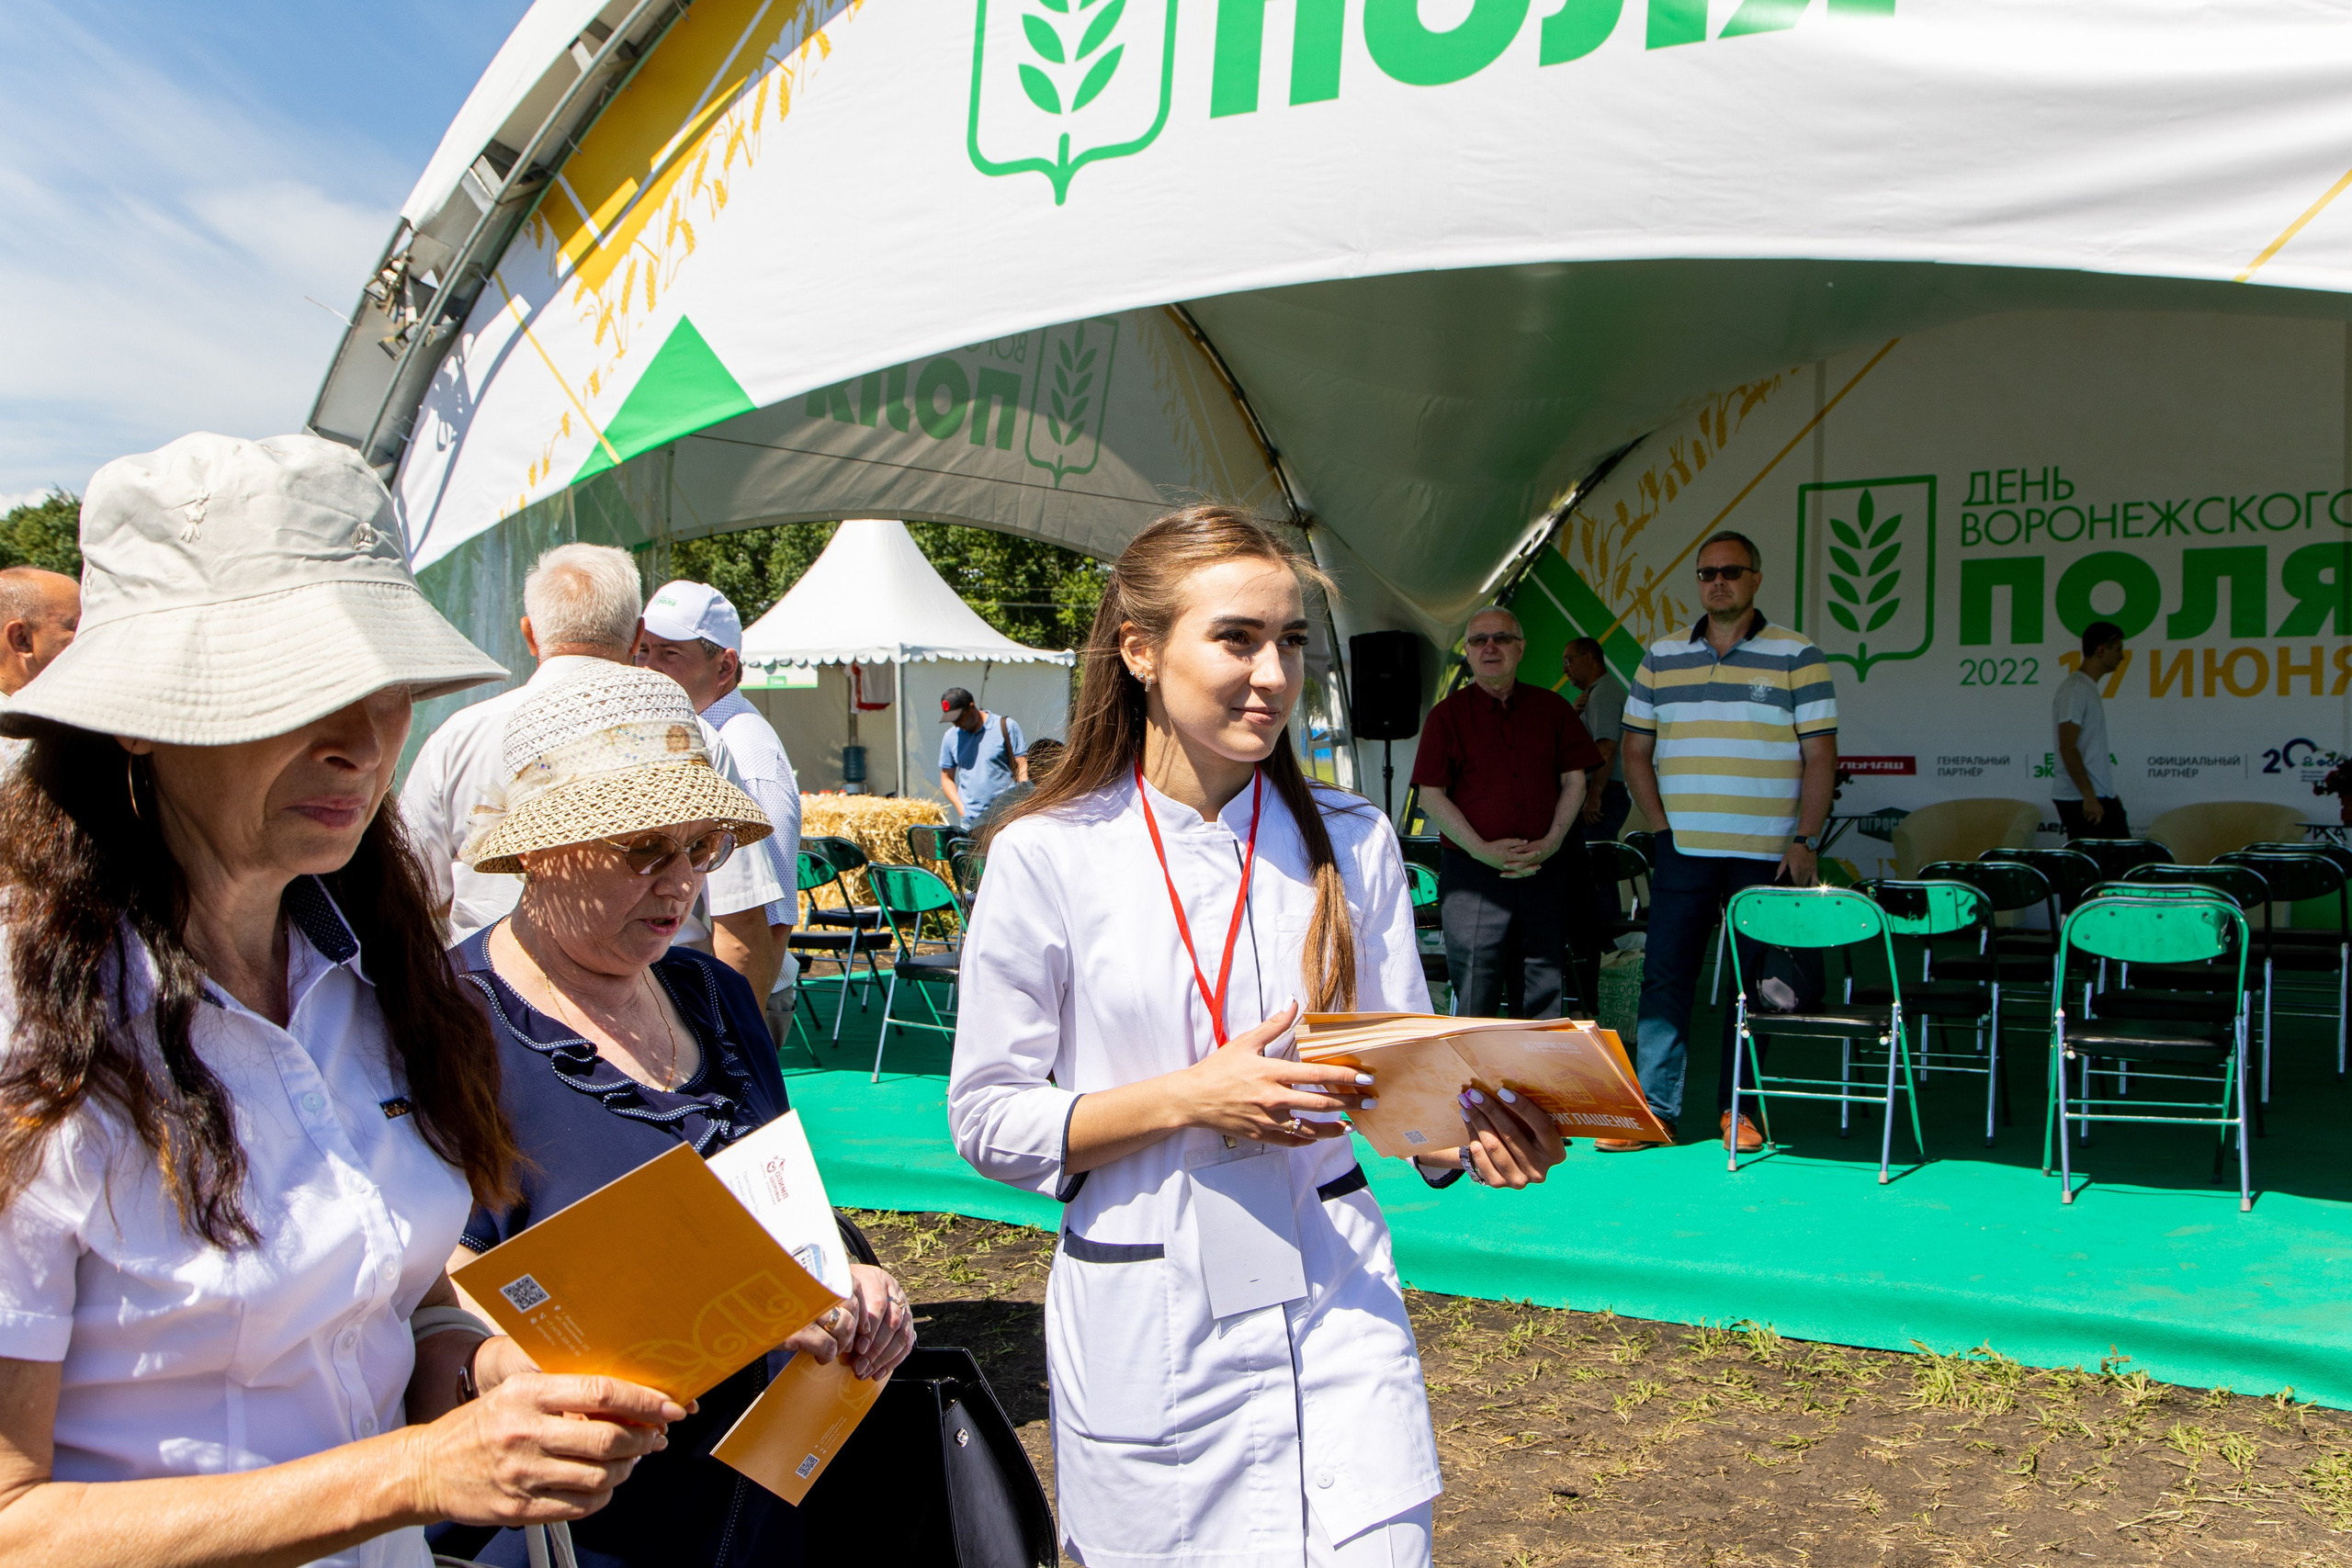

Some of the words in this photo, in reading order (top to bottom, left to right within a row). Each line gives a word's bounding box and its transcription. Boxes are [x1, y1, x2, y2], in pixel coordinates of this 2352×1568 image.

[1210, 0, 1896, 119] ПО
[1962, 467, 2075, 507] ДЕНЬ
[1960, 541, 2352, 646] ПОЛЯ
[1960, 658, 2040, 686] 2022
[1937, 755, 2010, 766] ГЕНЕРАЛЬНЫЙ
[2147, 755, 2241, 768] ОФИЦИАЛЬНЫЙ
[1550, 1113, 1644, 1131] РИГЛАШЕНИЕ
[775, 1171, 789, 1200] ОЛИМП
